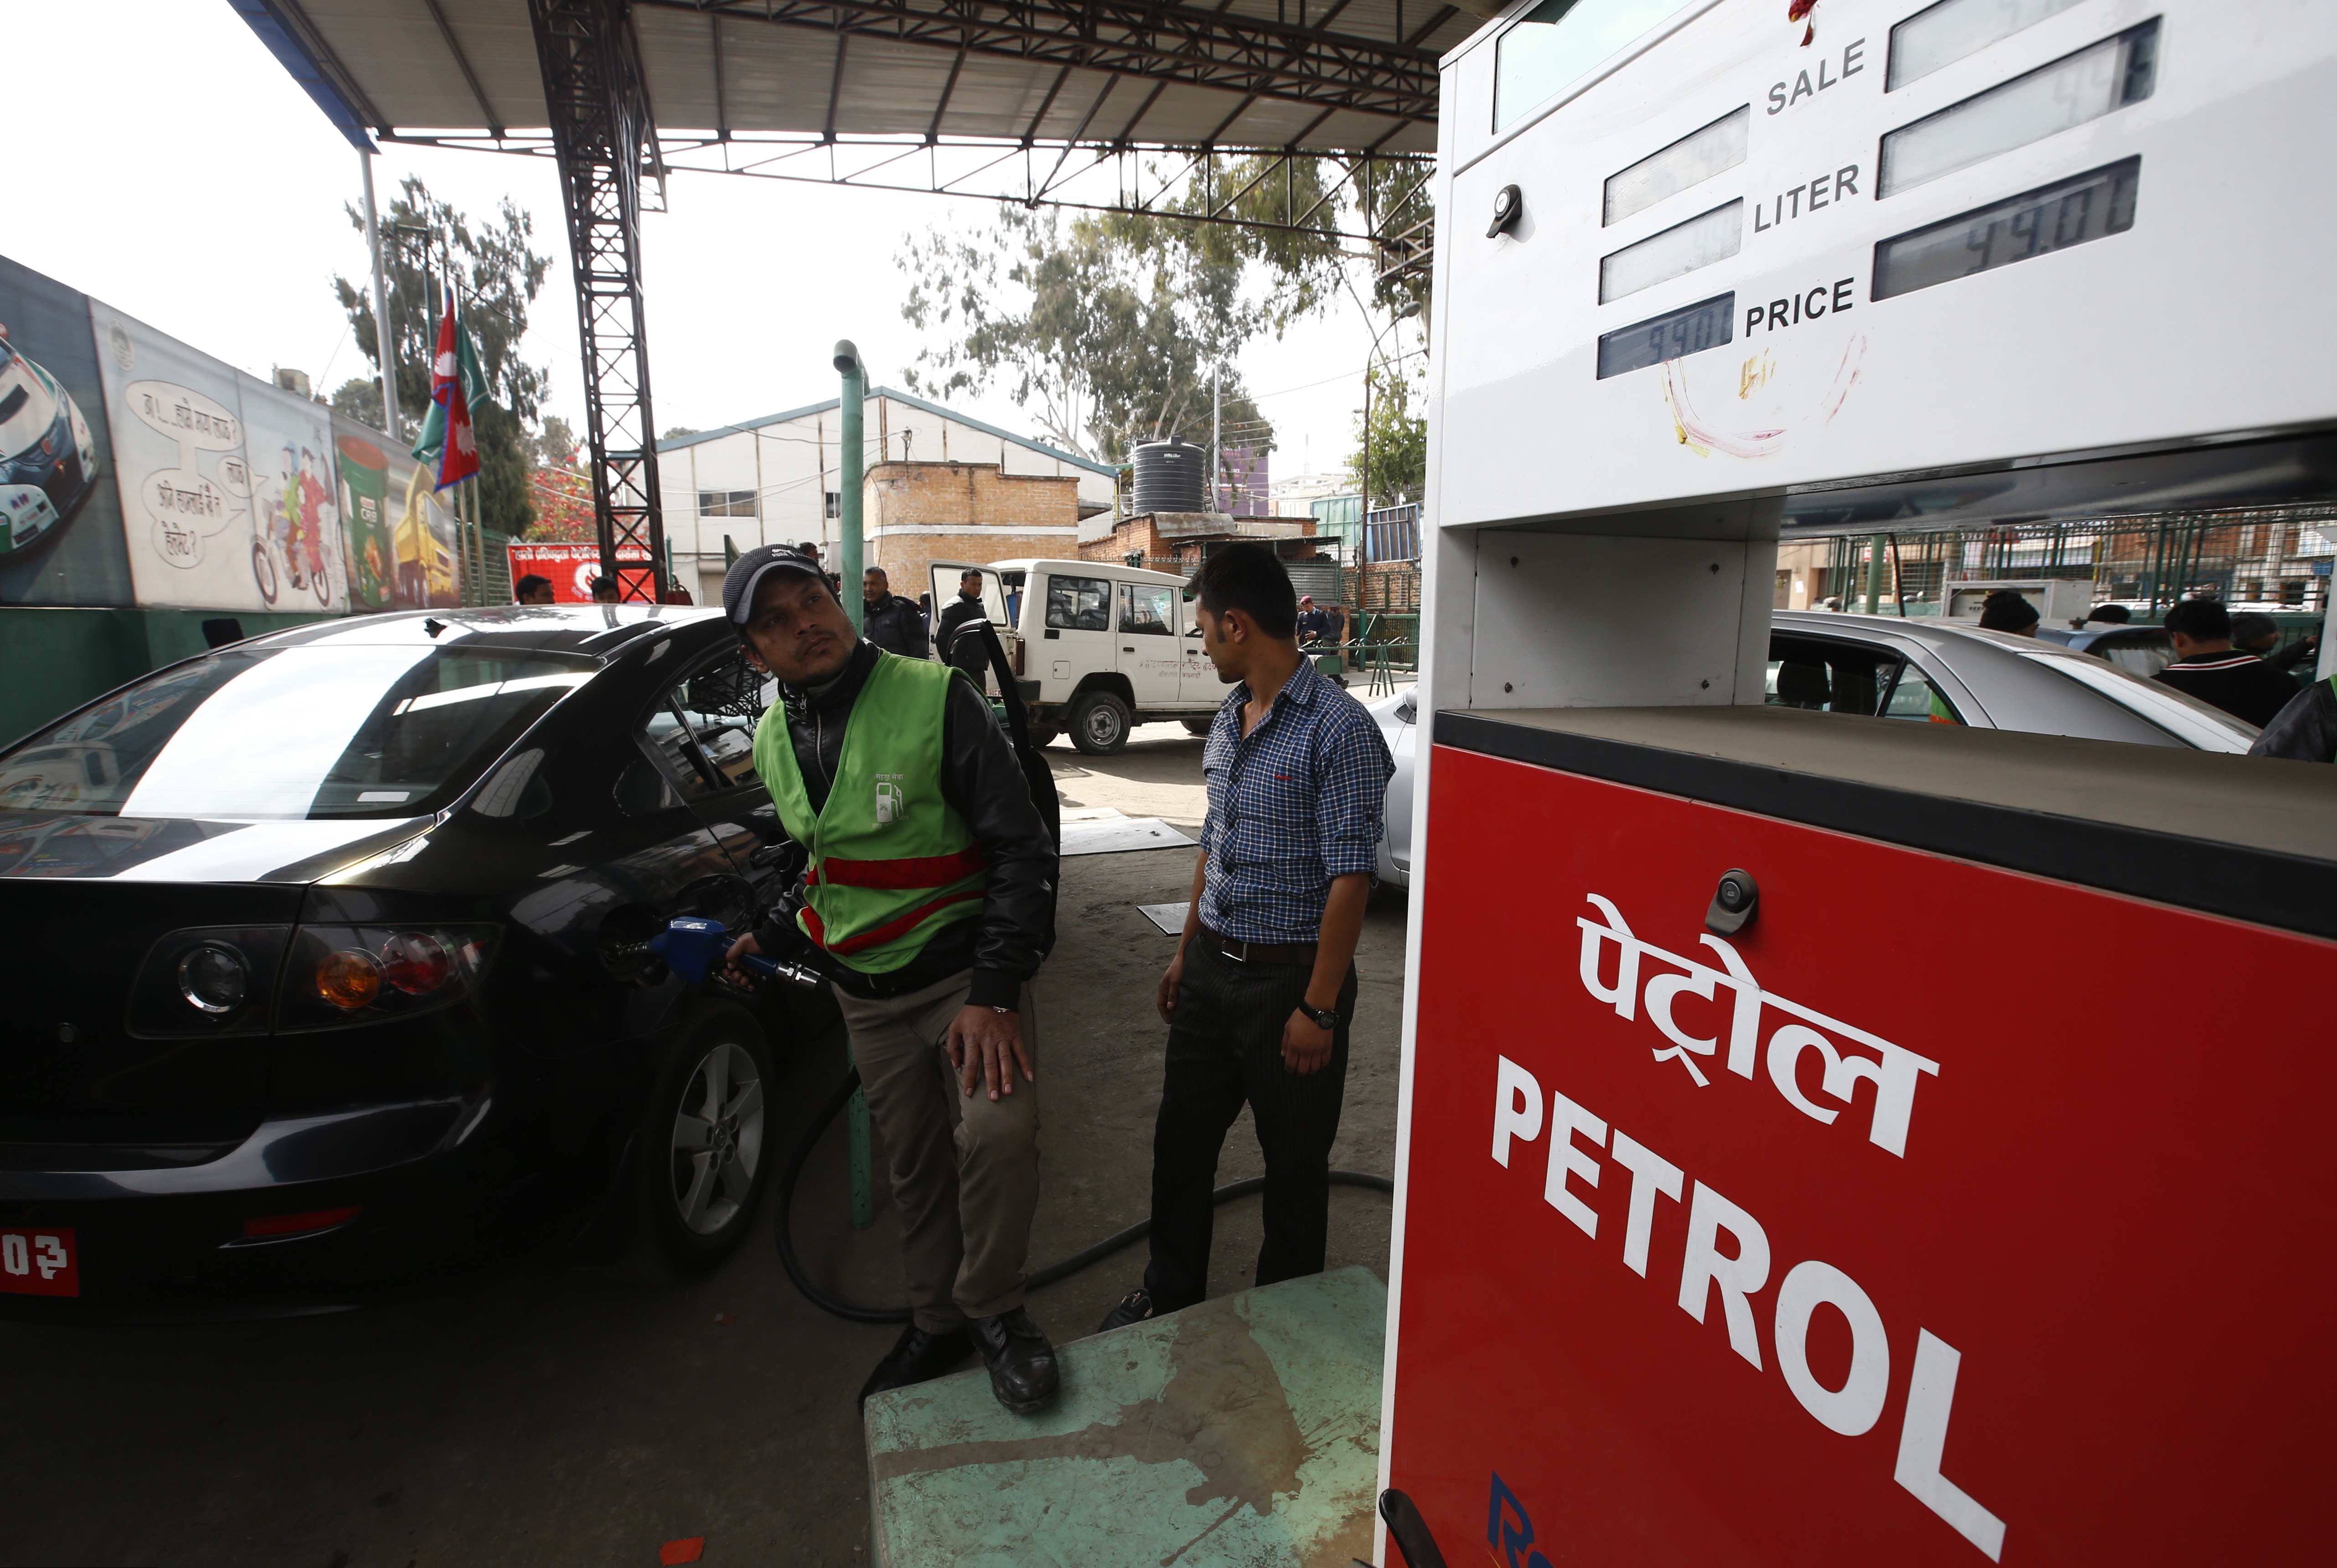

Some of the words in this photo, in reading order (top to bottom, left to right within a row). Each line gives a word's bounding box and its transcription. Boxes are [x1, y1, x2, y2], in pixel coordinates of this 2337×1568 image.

[1767, 38, 1865, 116] SALE
[1755, 165, 1859, 233] LITER
[1746, 277, 1854, 338] PRICE
[1576, 893, 1940, 1159] पेट्रोल
[1492, 1054, 2006, 1563] PETROL
